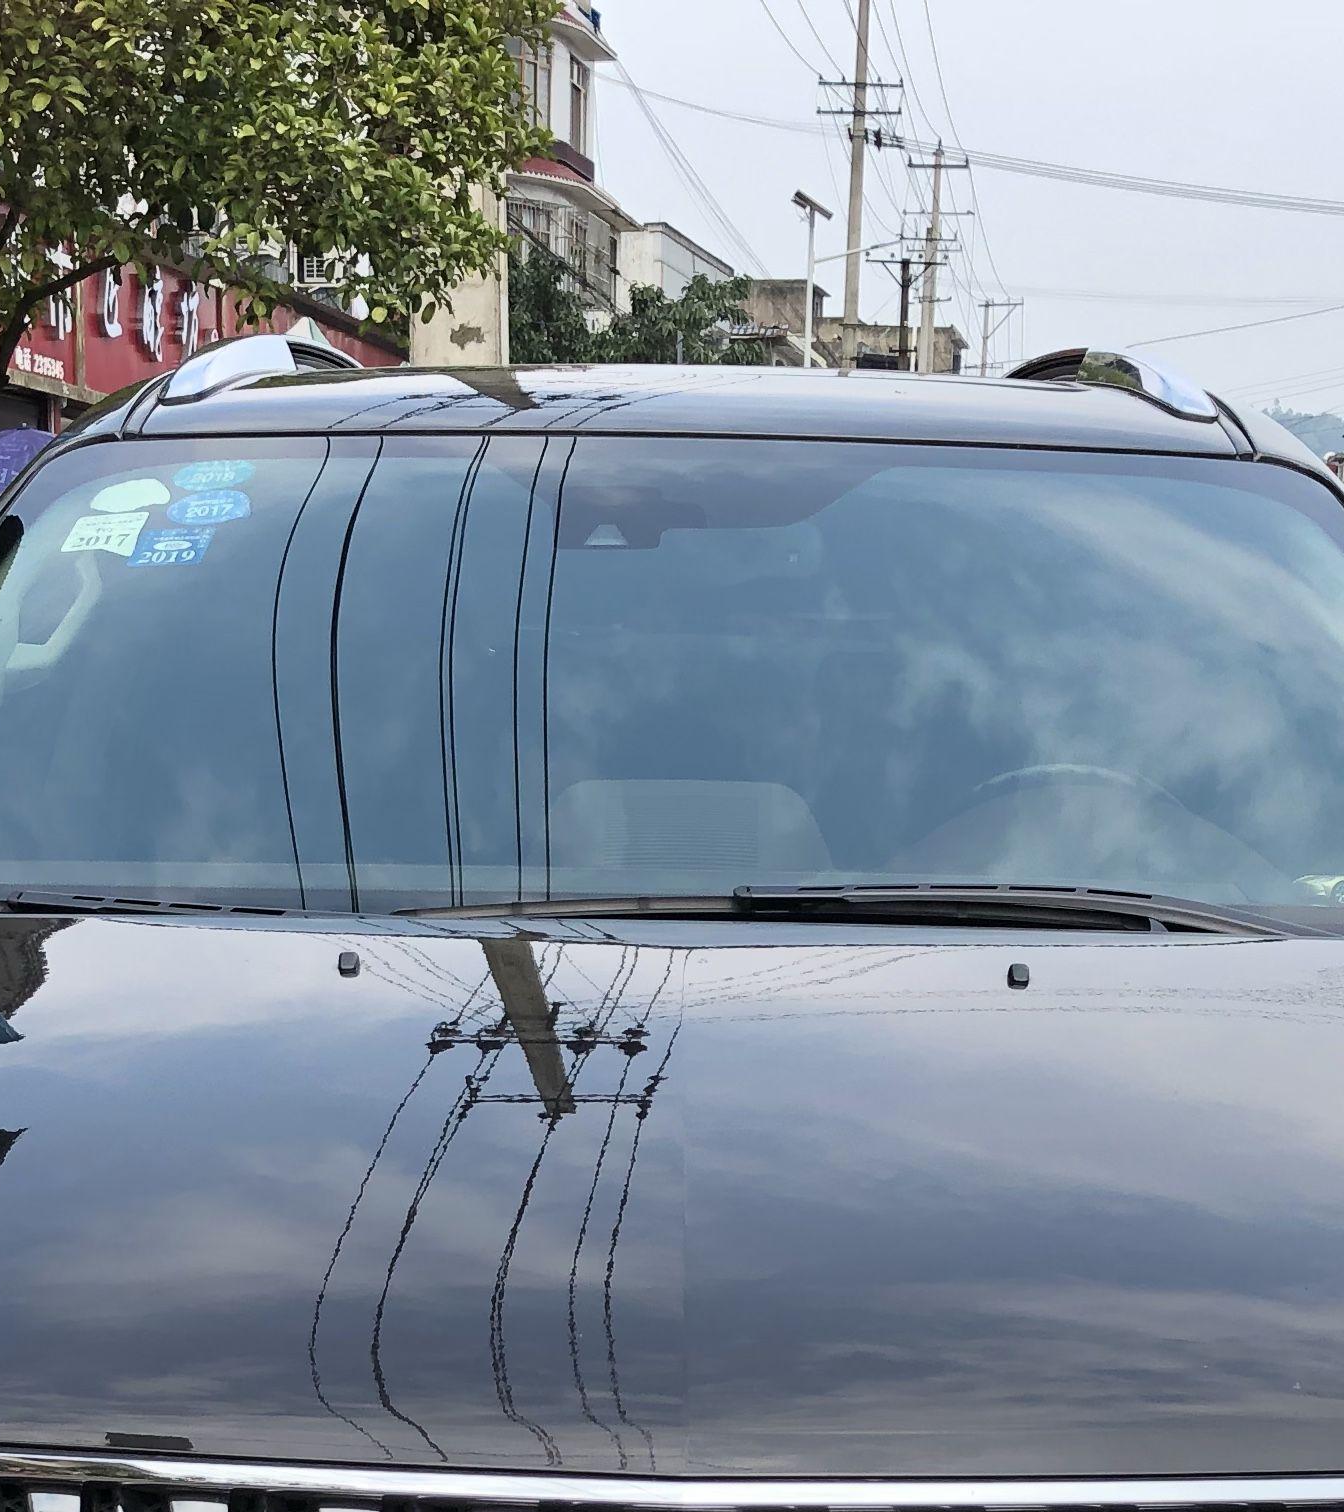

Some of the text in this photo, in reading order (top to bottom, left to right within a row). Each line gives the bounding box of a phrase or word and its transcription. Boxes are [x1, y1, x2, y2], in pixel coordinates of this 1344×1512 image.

[184, 503, 235, 518] 2017
[71, 533, 131, 548] 2017
[136, 550, 196, 564] 2019
